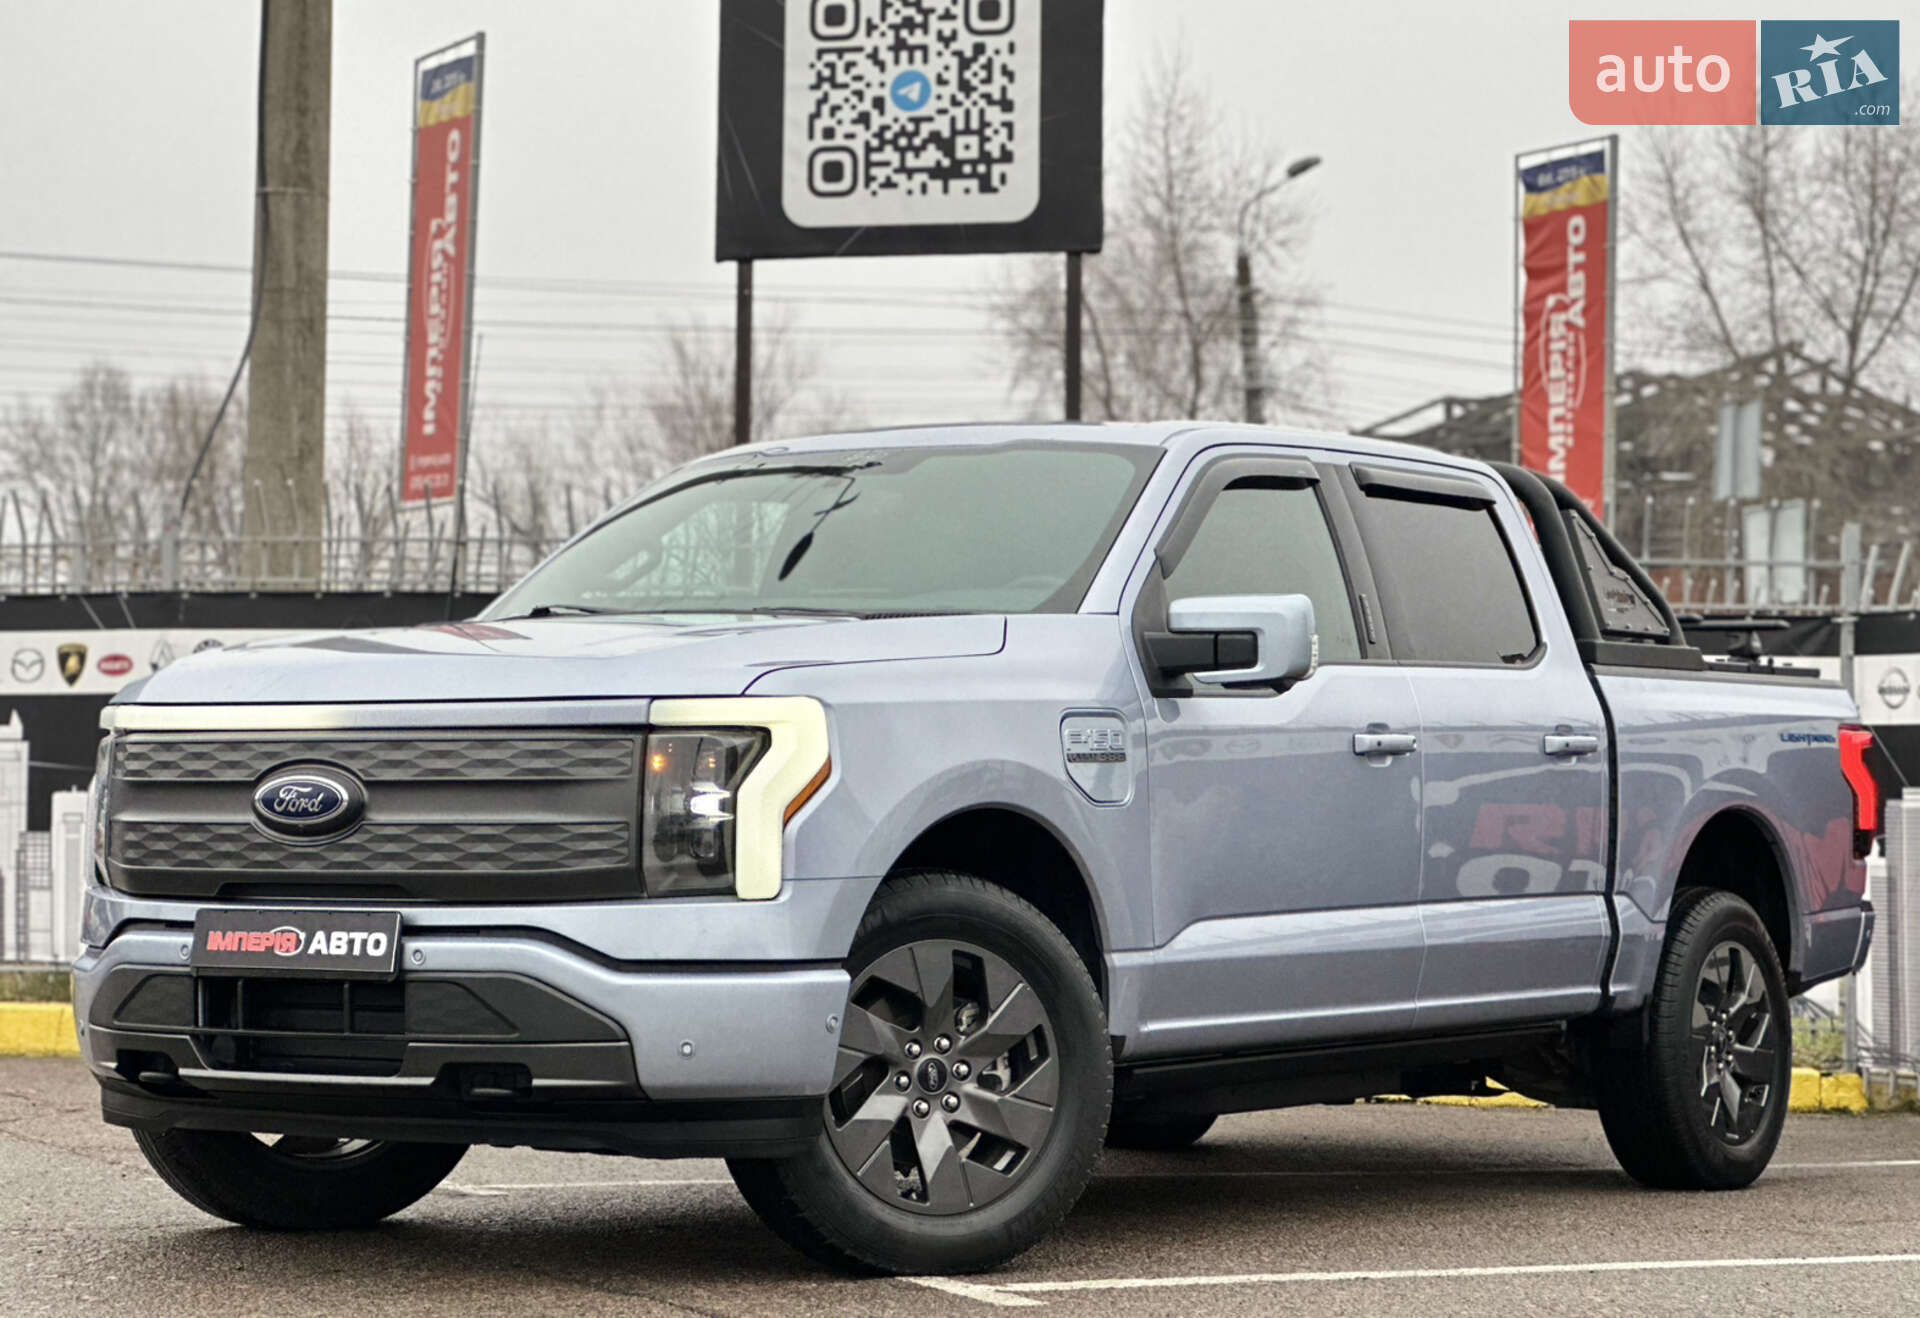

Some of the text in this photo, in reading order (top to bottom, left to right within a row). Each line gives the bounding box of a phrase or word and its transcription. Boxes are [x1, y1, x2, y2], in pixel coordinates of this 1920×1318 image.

[1566, 214, 1587, 329] АВТО
[274, 785, 325, 812] Ford
[307, 930, 388, 957] АВТО
